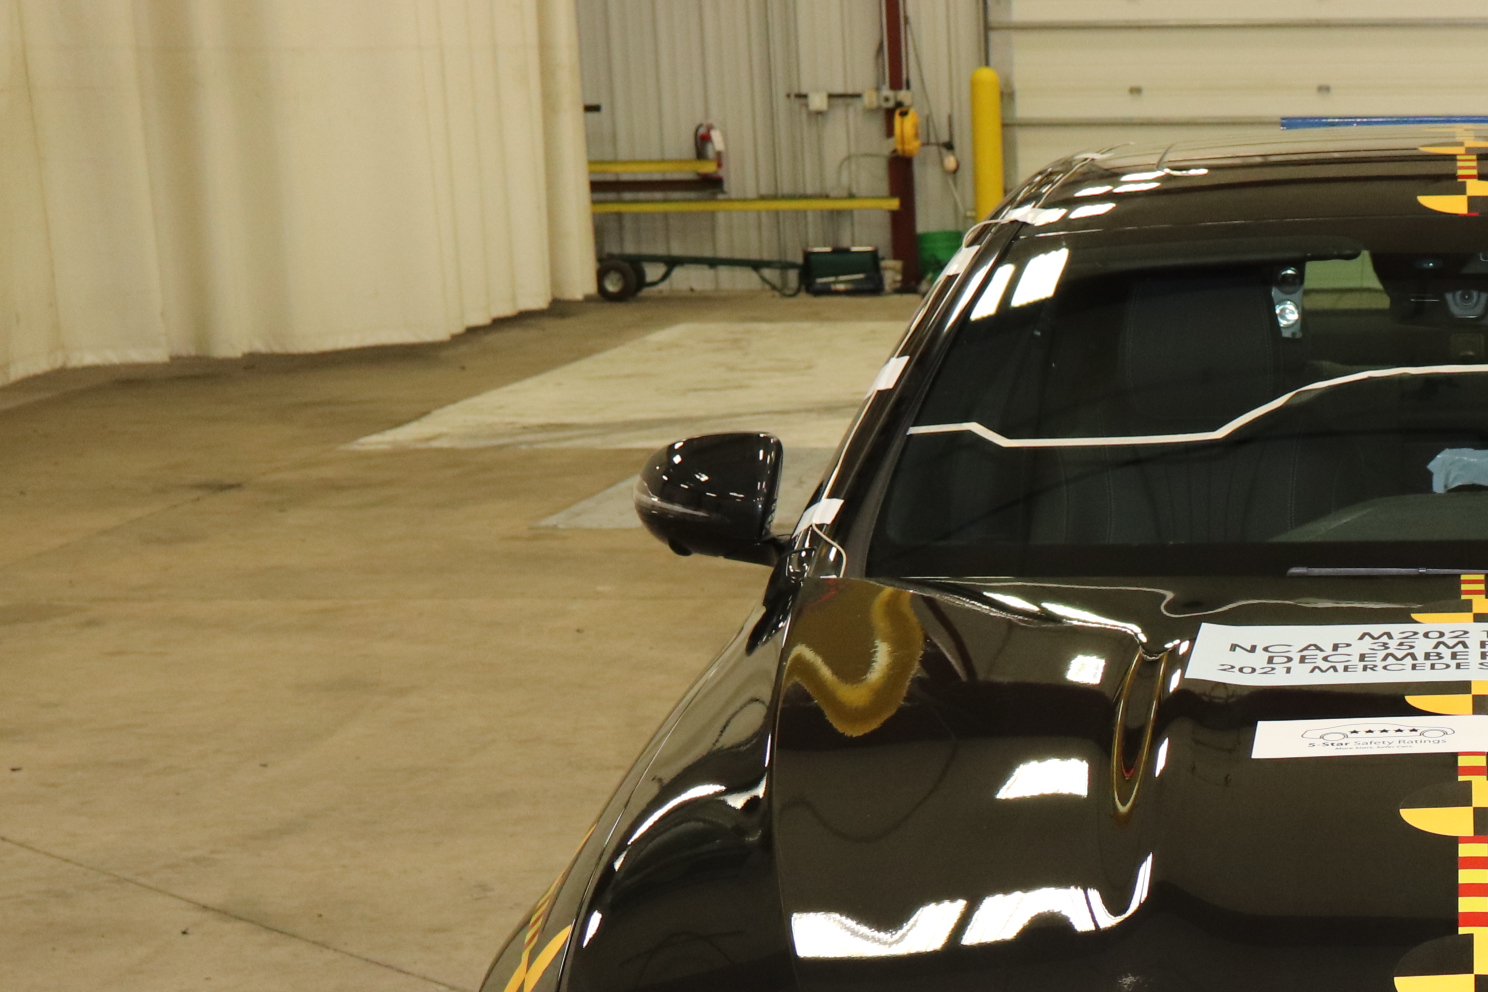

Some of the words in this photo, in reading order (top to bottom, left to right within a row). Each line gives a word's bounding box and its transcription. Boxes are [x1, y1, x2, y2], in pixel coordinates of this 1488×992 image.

[1229, 642, 1352, 654] NCAP
[1368, 641, 1416, 651] 35
[1217, 663, 1292, 675] 2021
